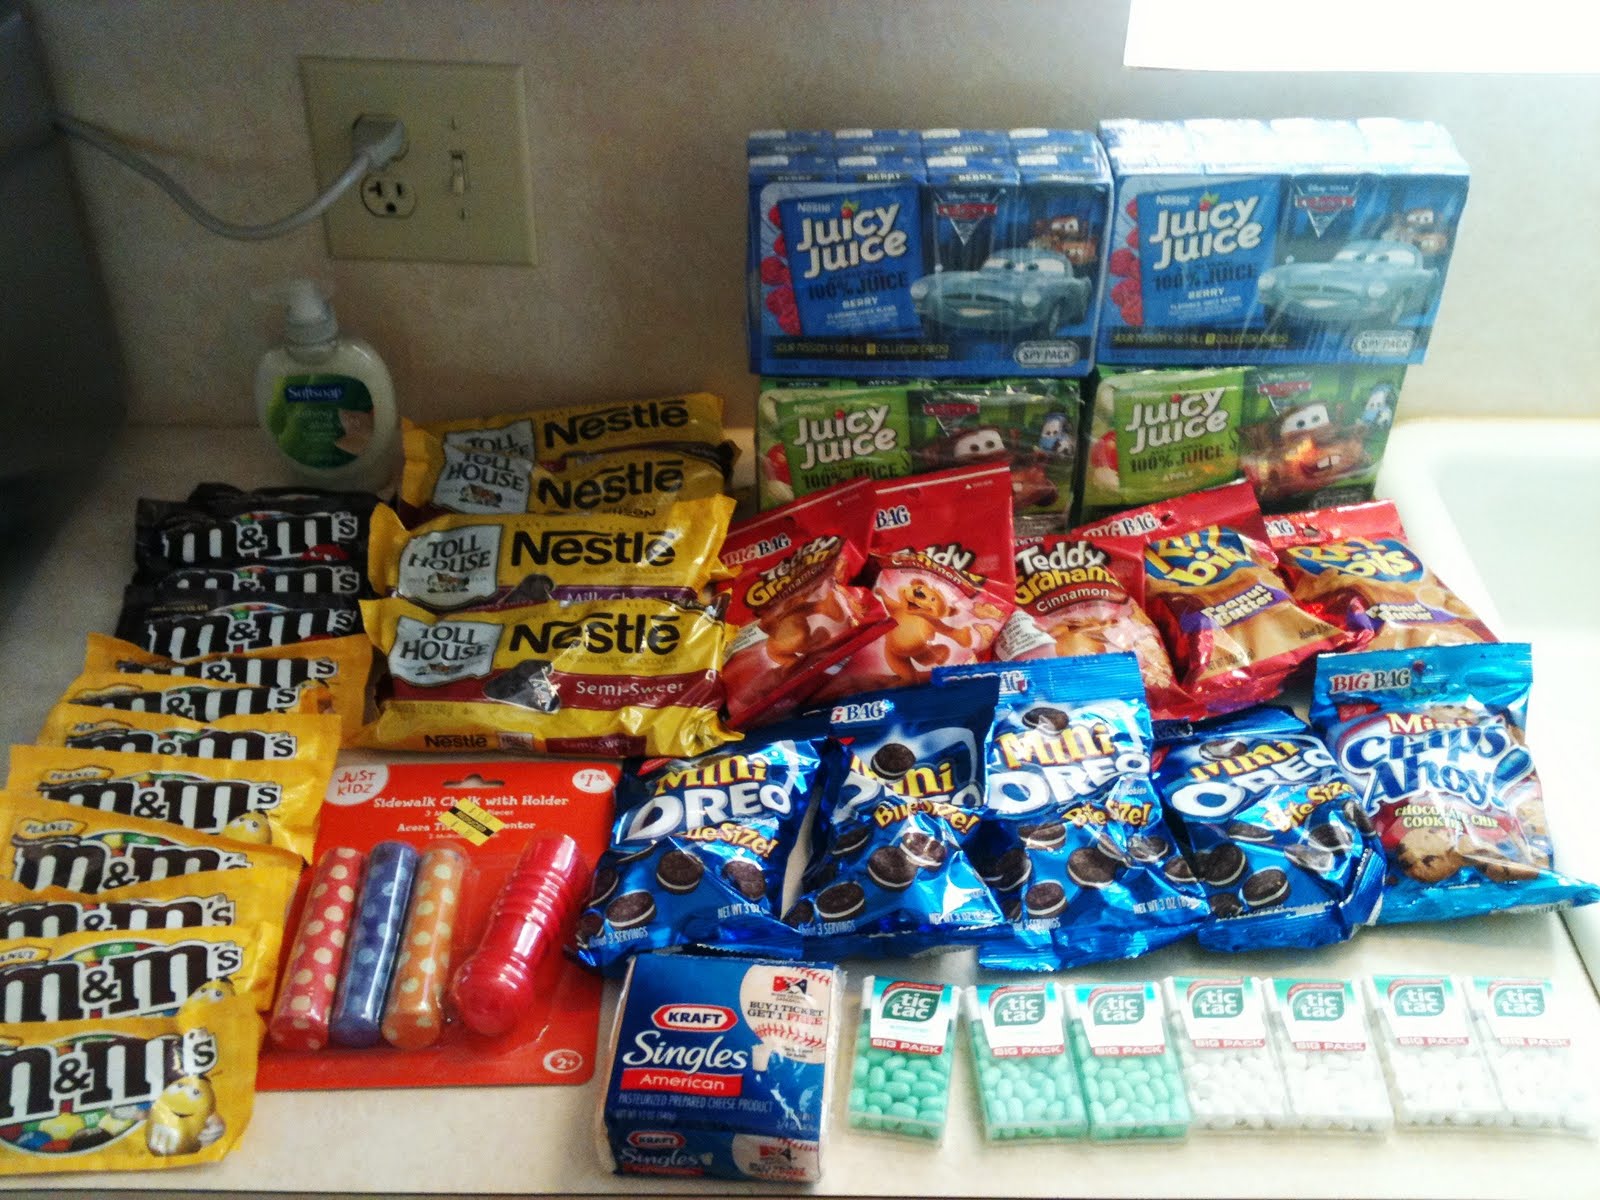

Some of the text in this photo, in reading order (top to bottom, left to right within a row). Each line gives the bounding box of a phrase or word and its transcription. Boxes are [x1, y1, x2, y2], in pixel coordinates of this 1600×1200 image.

[796, 203, 900, 250] Juicy
[1149, 195, 1260, 243] Juicy
[803, 229, 907, 279] Juice
[1153, 221, 1263, 271] Juice
[1124, 387, 1226, 432] Juicy
[793, 405, 889, 445] Juicy
[1129, 407, 1229, 456] Juice
[800, 427, 897, 470] Juice
[446, 465, 526, 493] HOUSE
[875, 505, 911, 529] BAG
[1121, 512, 1157, 535] BAG
[427, 535, 482, 560] TOLL
[407, 550, 491, 573] HOUSE
[1015, 540, 1106, 577] Teddy
[1036, 587, 1110, 612] Cinnamon
[418, 625, 476, 643] TOLL
[399, 640, 495, 662] HOUSE
[575, 680, 684, 696] Semi-Sweet
[999, 670, 1025, 693] AG
[1330, 668, 1411, 694] BIG BAG
[846, 701, 886, 720] BAG
[997, 724, 1115, 769] Mini
[337, 769, 377, 784] JUST
[655, 755, 768, 796] Mini
[986, 753, 1151, 815] OREO
[1171, 749, 1338, 817] OREO
[337, 783, 373, 796] KIDZ
[373, 795, 569, 808] Sidewalk Chlk with Holder
[624, 782, 791, 842] OREO
[721, 822, 780, 858] Size!
[614, 925, 649, 943] SERVINGS
[902, 992, 932, 1008] tic
[1006, 995, 1041, 1011] tic
[1106, 995, 1140, 1011] tic
[1205, 988, 1237, 1003] tic
[1305, 992, 1338, 1007] tic
[1405, 988, 1438, 1003] tic
[1505, 989, 1538, 1003] tic
[747, 1008, 776, 1019] GET
[749, 1001, 773, 1010] BUY
[781, 1004, 824, 1017] TICKET
[891, 1004, 929, 1020] tac
[1001, 1007, 1039, 1022] tac
[1101, 1007, 1139, 1022] tac
[1199, 1001, 1238, 1016] tac
[1300, 1005, 1339, 1018] tac
[1400, 1000, 1439, 1014] tac
[1499, 1001, 1539, 1014] tac
[667, 1012, 723, 1025] KRAFT
[872, 1038, 940, 1053] BIG PACK
[993, 1045, 1063, 1056] BIG PACK
[1095, 1045, 1165, 1056] BIG PACK
[1194, 1039, 1264, 1048] BIG PACK
[1295, 1042, 1366, 1051] BIG PACK
[1399, 1037, 1467, 1046] BIG PACK
[1500, 1038, 1570, 1047] BIG PACK
[622, 1030, 749, 1075] Singles
[639, 1072, 725, 1091] American
[618, 1093, 775, 1113] PASTEURIZED PREPARED CHEESE PRODUCT
